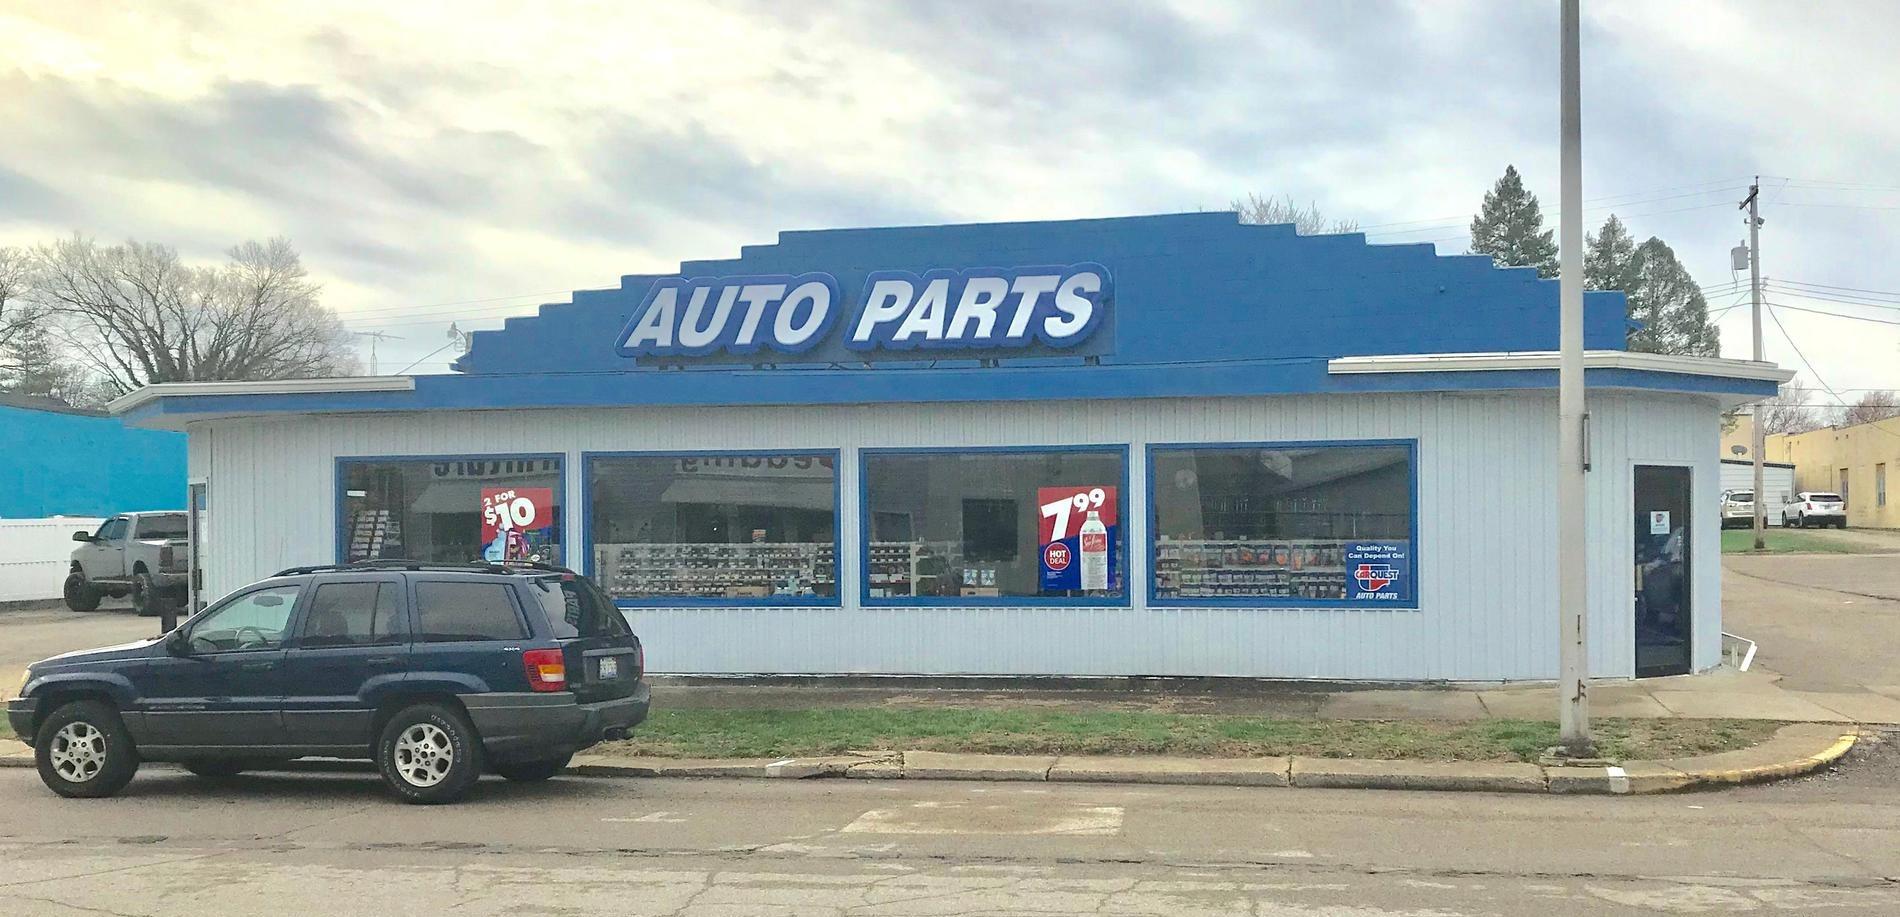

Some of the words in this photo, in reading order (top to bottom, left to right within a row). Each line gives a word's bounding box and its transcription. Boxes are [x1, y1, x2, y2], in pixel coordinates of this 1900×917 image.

[623, 281, 831, 348] AUTO
[852, 271, 1101, 342] PARTS
[484, 497, 491, 507] 2
[495, 490, 516, 502] FOR
[484, 497, 536, 532] $10
[1049, 550, 1067, 558] HOT
[1049, 557, 1067, 565] DEAL
[1356, 571, 1398, 579] CARQUEST
